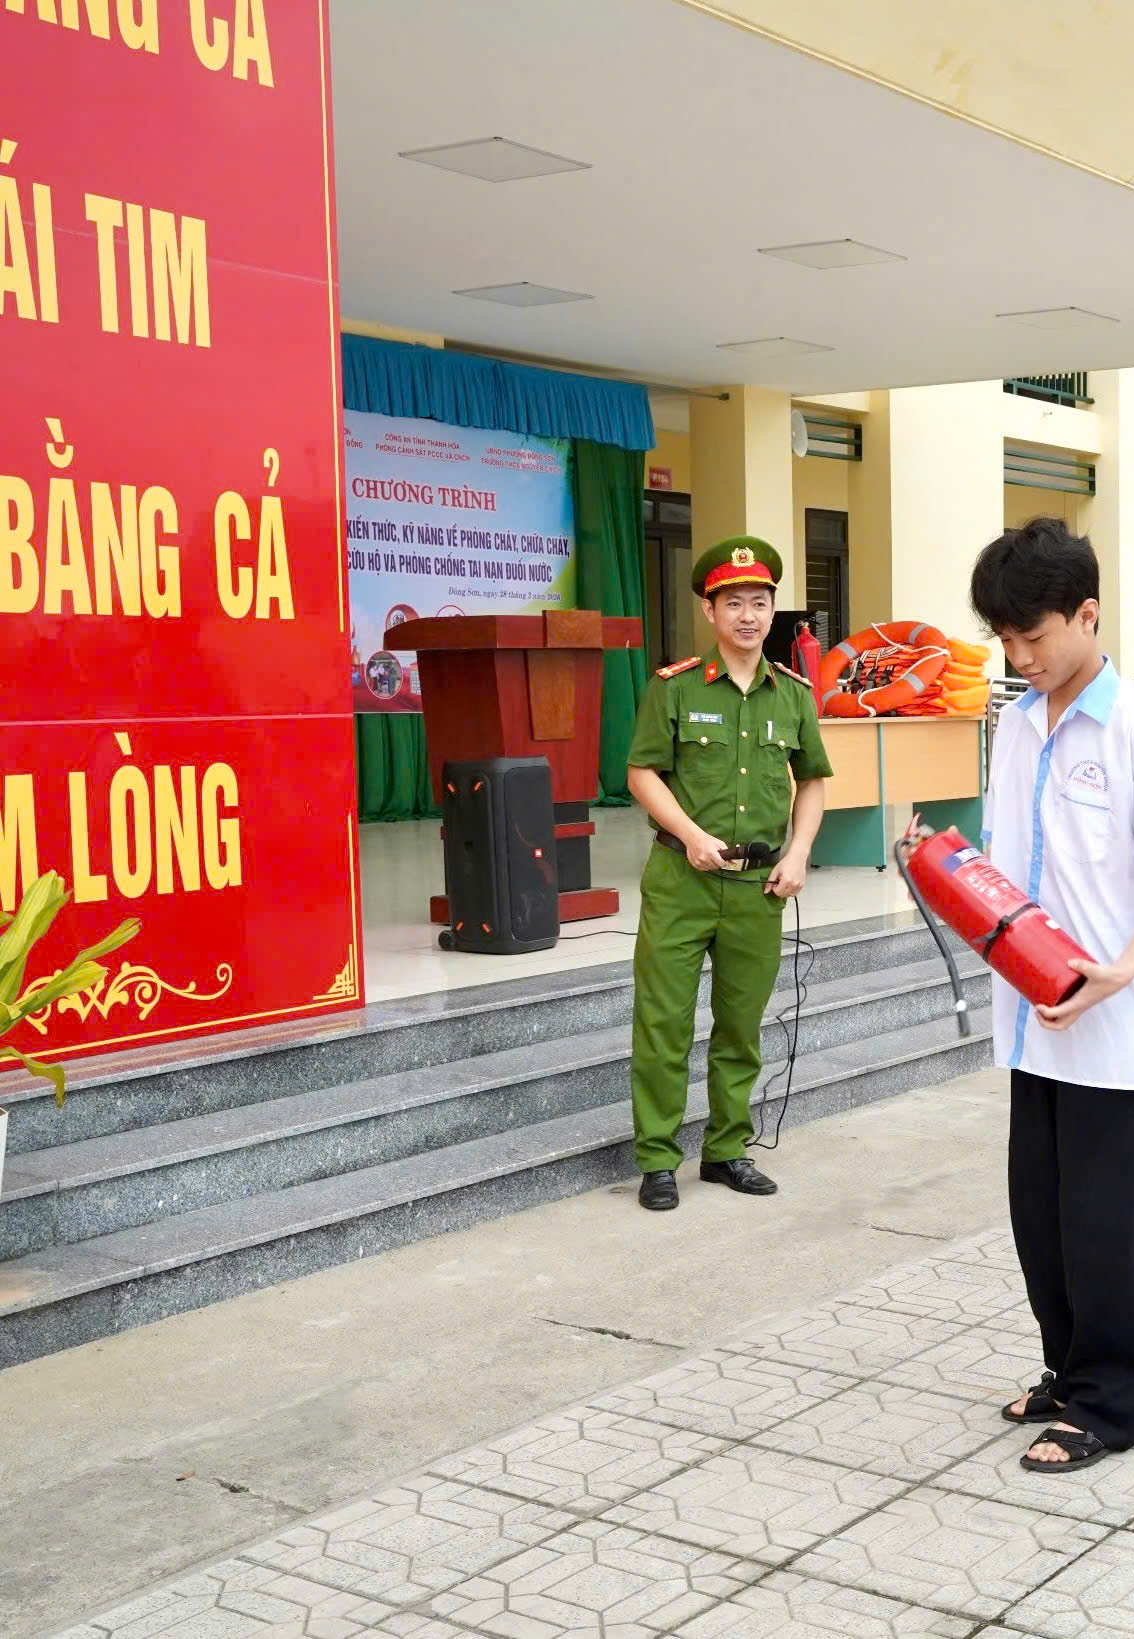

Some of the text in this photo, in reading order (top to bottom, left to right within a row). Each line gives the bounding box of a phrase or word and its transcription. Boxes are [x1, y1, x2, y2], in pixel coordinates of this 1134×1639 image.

[84, 193, 211, 348] TIM
[385, 433, 402, 443] CÔNG
[403, 436, 412, 444] AN
[427, 439, 447, 448] THANH
[351, 477, 497, 512] CHƯƠNG TRÌNH
[0, 417, 295, 619] BẰNG CẢ
[346, 514, 370, 540] KIẾN
[372, 518, 400, 545] THỨC,
[402, 521, 415, 544] KỸ
[417, 523, 445, 547] NĂNG
[460, 526, 492, 550] PHÒNG
[494, 530, 519, 554] CHÁY,
[521, 533, 545, 554] CHỮA
[546, 535, 570, 558] CHÁY,
[346, 547, 553, 584] CỨU HỘ VÀ PHÒNG CHỐNG TAI NẠN ĐUỐI NƯỚC
[508, 590, 527, 599] tháng
[68, 731, 242, 903] LÒNG
